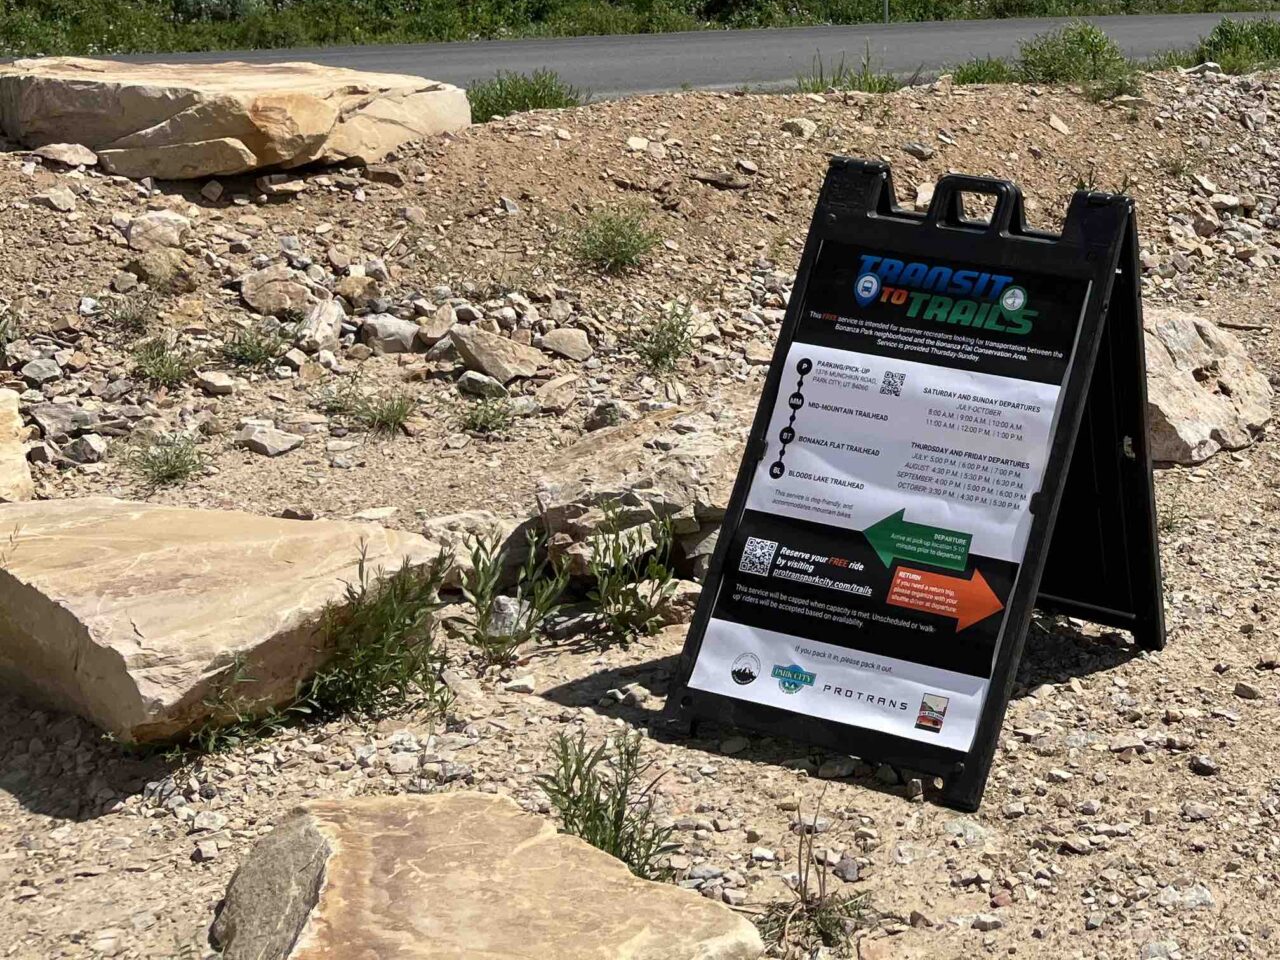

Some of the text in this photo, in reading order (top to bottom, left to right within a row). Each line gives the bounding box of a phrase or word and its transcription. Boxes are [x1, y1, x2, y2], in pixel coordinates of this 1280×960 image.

[854, 253, 1013, 302] TRANSIT
[878, 285, 909, 306] TO
[903, 290, 1039, 337] TRAILS
[834, 323, 860, 333] Bonanza
[873, 330, 913, 342] neighborhood
[935, 340, 960, 350] Bonanza
[972, 346, 1012, 358] Conservation
[837, 315, 858, 324] service
[864, 319, 889, 330] intended
[898, 325, 922, 335] summer
[923, 329, 953, 340] recreators
[952, 334, 975, 344] looking
[984, 339, 1026, 352] transportation
[1026, 346, 1053, 357] between
[876, 338, 897, 348] Service
[903, 343, 929, 353] provided
[816, 360, 870, 374] PARKING/PICK-UP
[828, 370, 859, 381] MUNCHKIN
[923, 386, 957, 398] SATURDAY
[971, 395, 997, 405] SUNDAY
[998, 400, 1041, 413] DEPARTURES
[807, 401, 888, 421] MID-MOUNTAIN TRAILHEAD
[955, 403, 1001, 417] JULY-OCTOBER
[991, 419, 1009, 428] 10:00
[798, 435, 828, 446] BONANZA
[845, 444, 880, 456] TRAILHEAD
[910, 441, 949, 454] THURDSDAY
[963, 451, 987, 461] FRIDAY
[987, 456, 1030, 469] DEPARTURES
[788, 470, 812, 480] BLOODS
[829, 478, 864, 490] TRAILHEAD
[785, 491, 804, 500] service
[811, 505, 835, 515] mountain
[933, 533, 967, 545] DEPARTURE
[779, 546, 810, 560] Reserve
[810, 552, 828, 564] your
[828, 556, 848, 568] FREE
[786, 558, 814, 572] visiting
[772, 567, 873, 596] protransparkcity.com/trails
[898, 571, 921, 580] RETURN
[741, 595, 759, 605] riders
[778, 602, 805, 615] accepted
[804, 608, 823, 619] based
[747, 586, 769, 597] service
[787, 594, 810, 606] capped
[825, 603, 851, 615] capacity
[871, 612, 910, 627] Unscheduled
[840, 655, 860, 665] please
[774, 667, 811, 682] PARK CITY
[822, 684, 909, 710] PROTRANS
